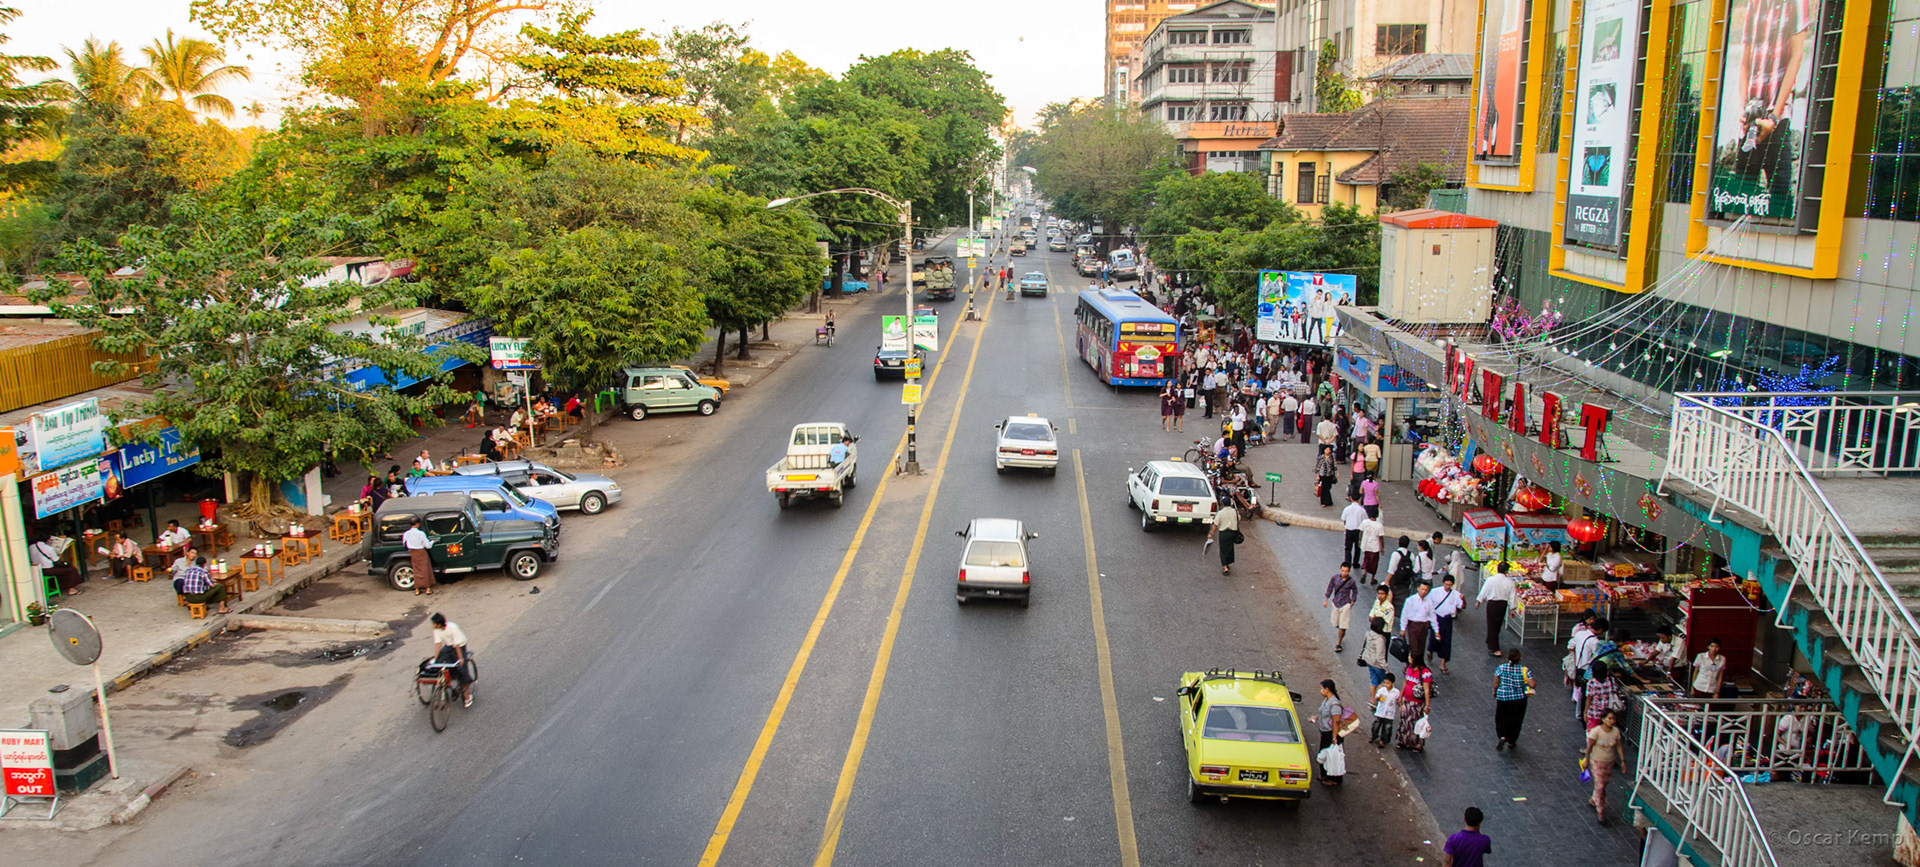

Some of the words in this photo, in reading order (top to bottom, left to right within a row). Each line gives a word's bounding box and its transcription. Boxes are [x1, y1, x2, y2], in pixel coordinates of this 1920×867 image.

[1575, 205, 1609, 223] REGZA
[1580, 223, 1596, 233] BETTER
[491, 342, 511, 351] LUCKY
[61, 410, 73, 431] Top
[75, 399, 98, 423] Travels
[1481, 368, 1610, 462] MART
[119, 447, 155, 471] Lucky
[1, 738, 21, 746] RUBY
[24, 738, 45, 746] MART
[11, 768, 46, 784] အထွက်
[17, 785, 43, 793] OUT
